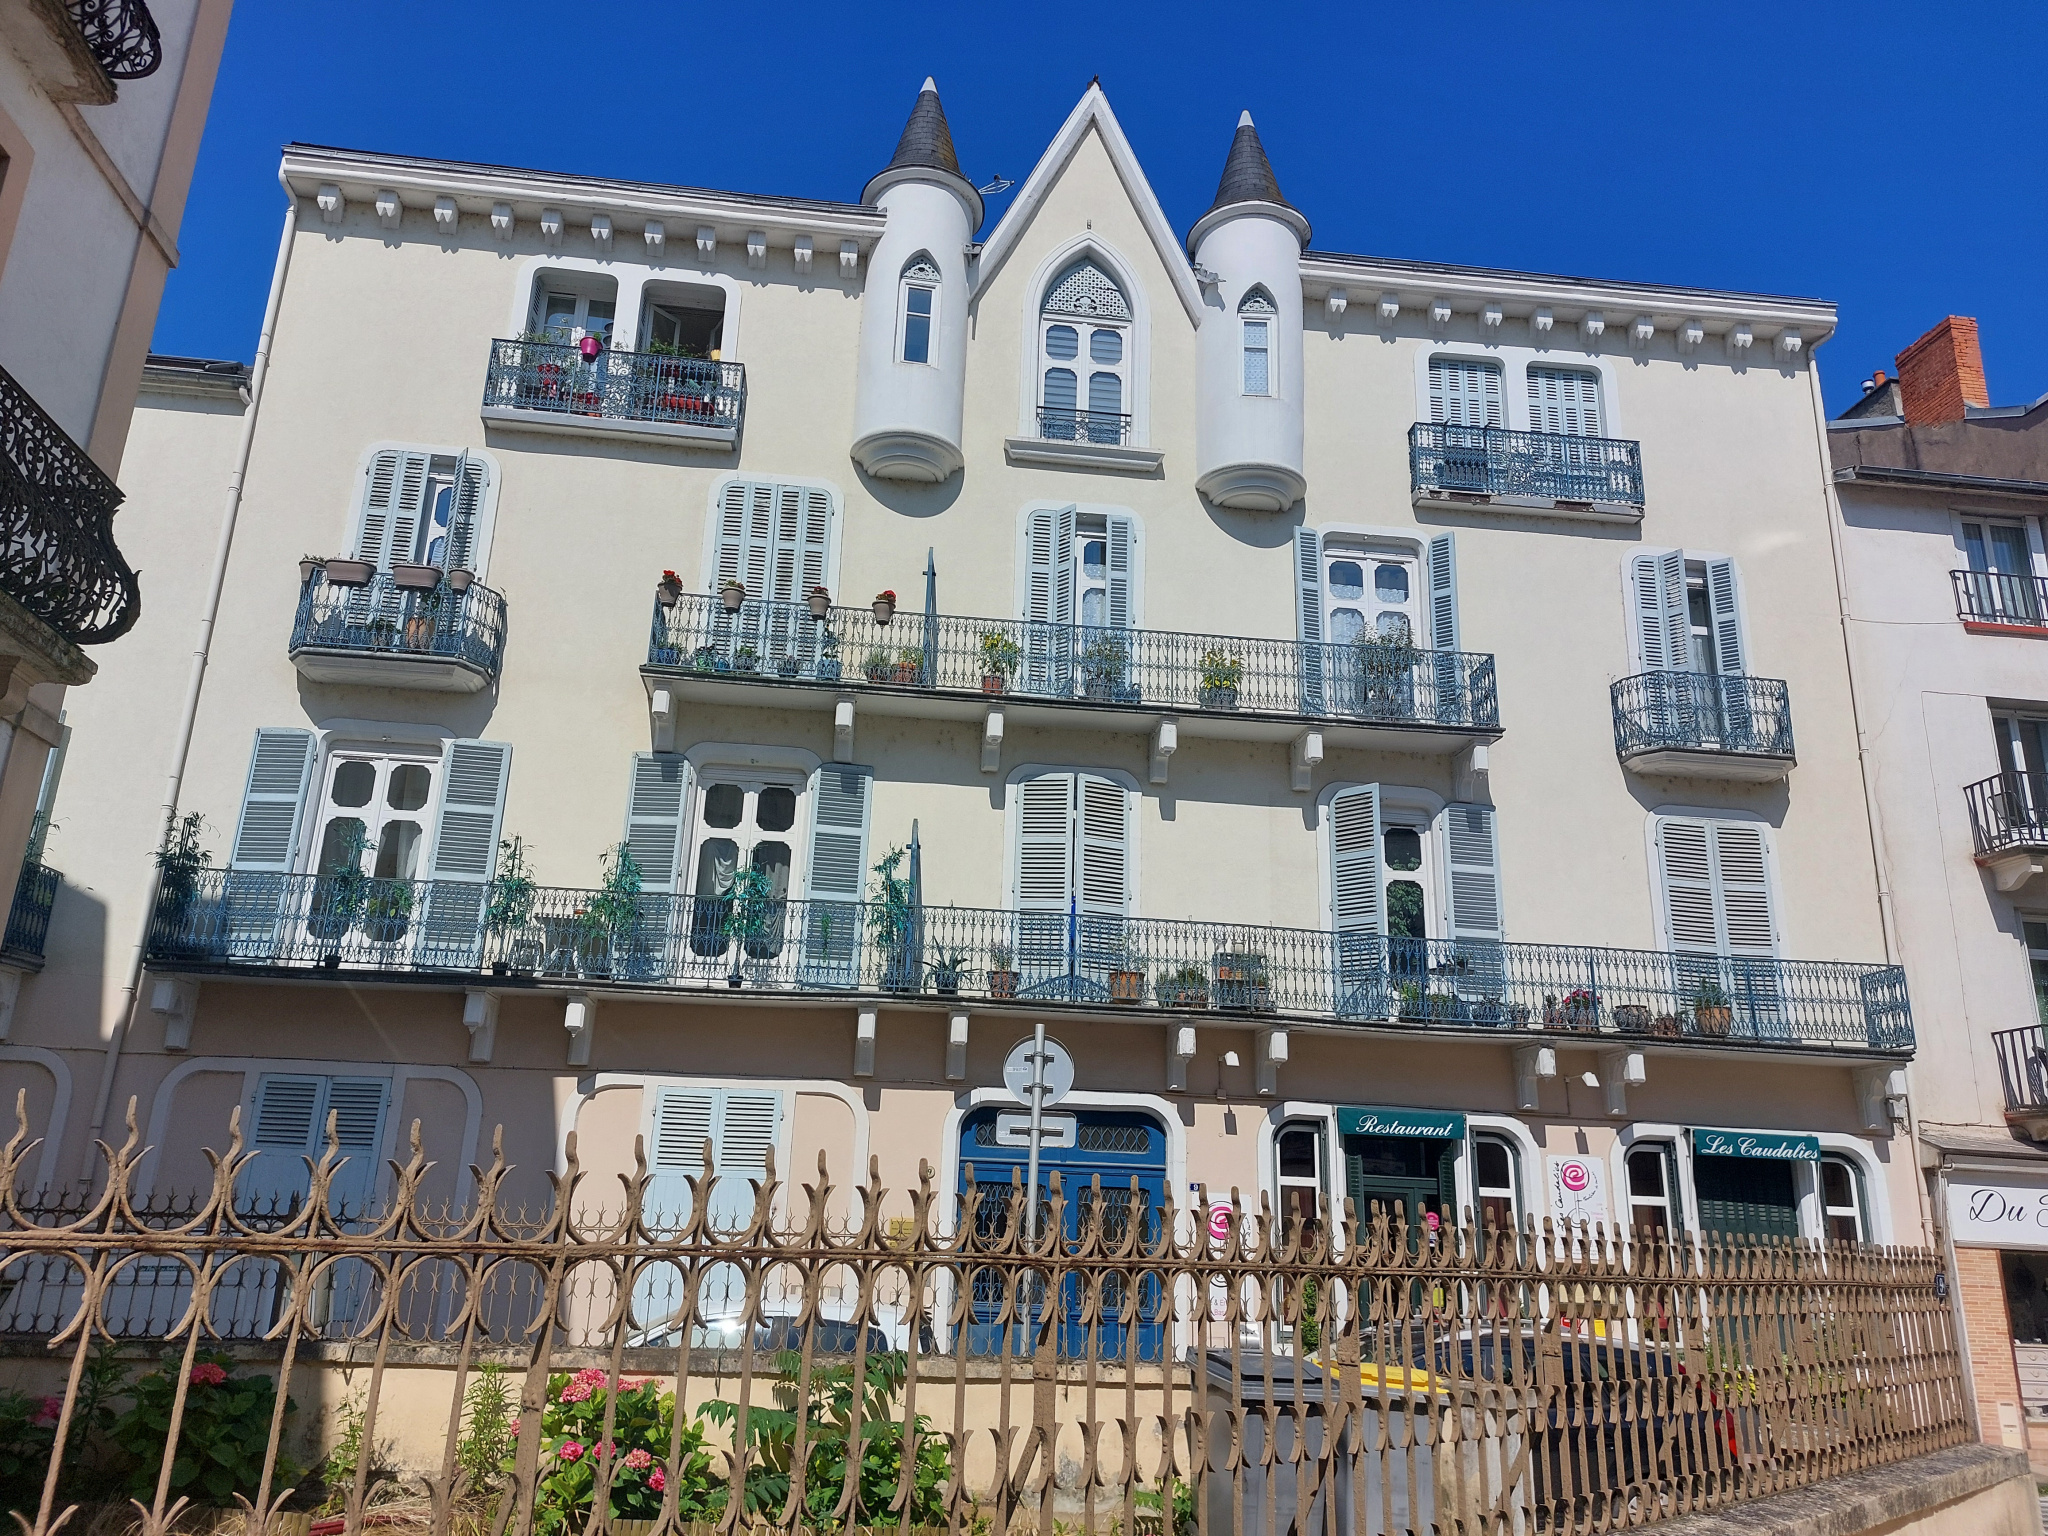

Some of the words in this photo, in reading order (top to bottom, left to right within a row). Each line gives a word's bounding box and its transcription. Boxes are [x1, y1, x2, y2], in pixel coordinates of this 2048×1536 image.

[1355, 1114, 1454, 1137] Restaurant
[1701, 1135, 1734, 1155] Les
[1737, 1137, 1818, 1159] Caudalies
[1193, 1183, 1199, 1191] 9
[1969, 1188, 2027, 1222] Du
